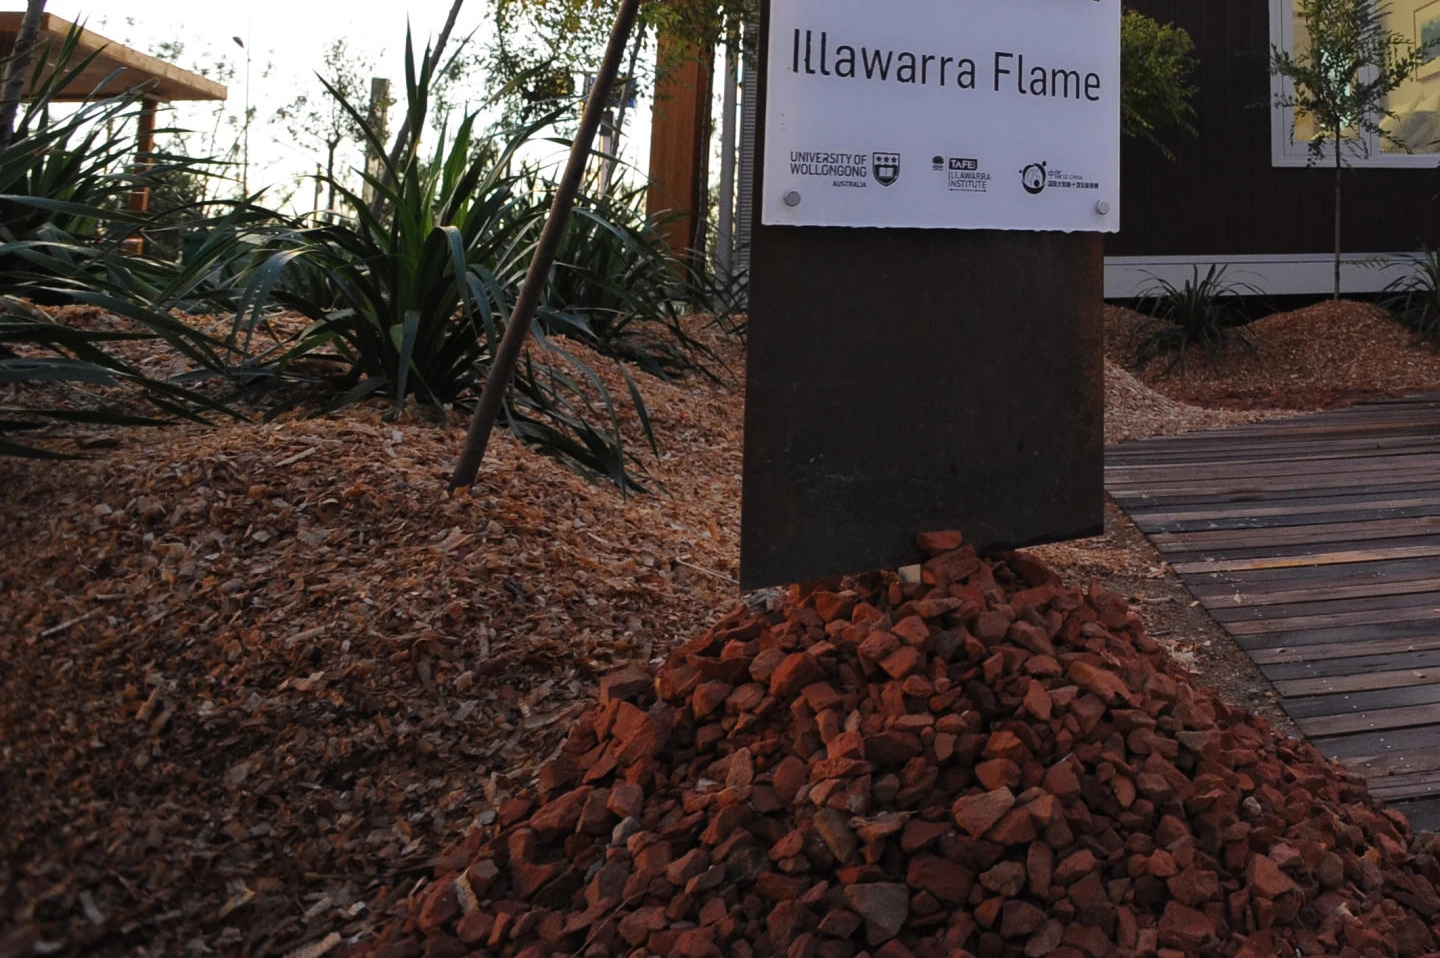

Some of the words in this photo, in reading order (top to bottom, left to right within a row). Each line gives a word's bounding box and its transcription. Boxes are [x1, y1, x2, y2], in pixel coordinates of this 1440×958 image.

[792, 28, 976, 90] Illawarra
[994, 51, 1101, 101] Flame
[790, 151, 852, 164] UNIVERSITY
[854, 154, 867, 165] OF
[950, 159, 975, 169] TAFE
[790, 163, 867, 177] WOLLONGONG
[832, 180, 867, 188] AUSTRALIA
